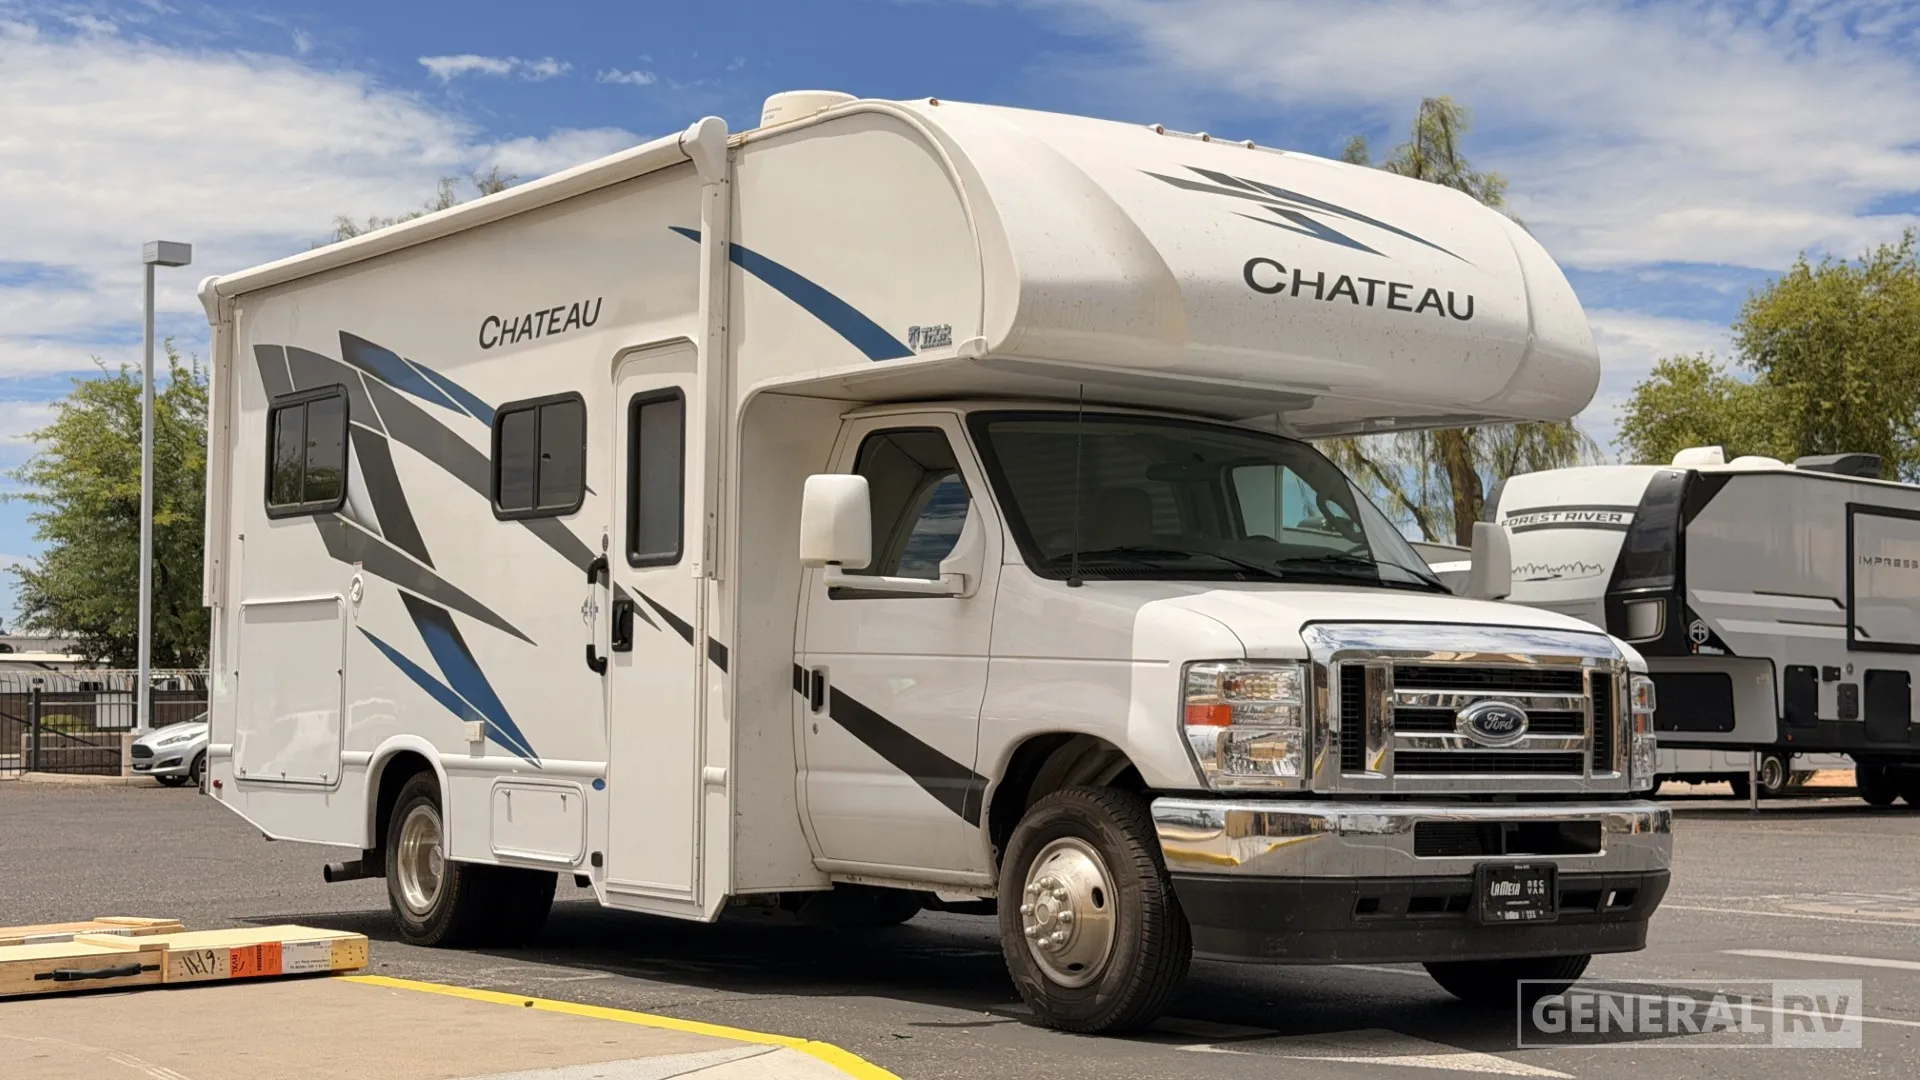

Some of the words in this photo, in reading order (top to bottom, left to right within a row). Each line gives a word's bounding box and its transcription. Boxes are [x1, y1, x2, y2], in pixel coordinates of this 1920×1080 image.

[1243, 257, 1474, 321] CHATEAU
[478, 296, 603, 349] CHATEAU
[1501, 512, 1561, 527] FOREST
[1564, 512, 1623, 523] RIVER
[1484, 712, 1515, 730] Ford
